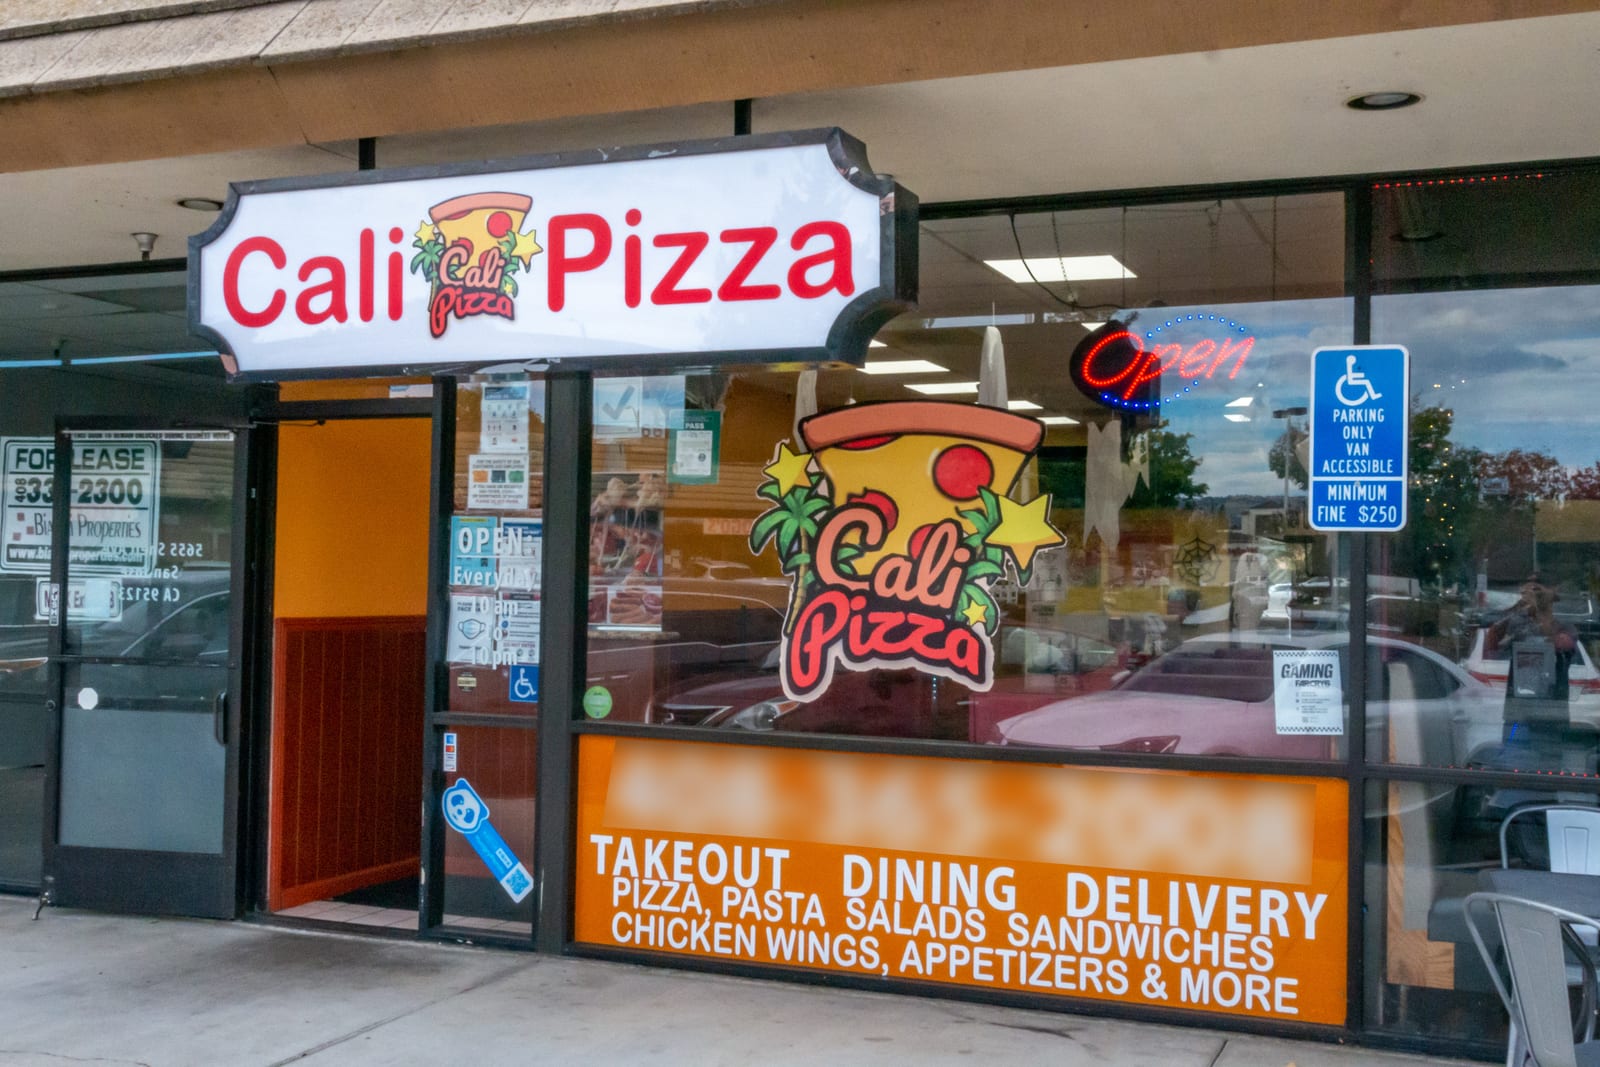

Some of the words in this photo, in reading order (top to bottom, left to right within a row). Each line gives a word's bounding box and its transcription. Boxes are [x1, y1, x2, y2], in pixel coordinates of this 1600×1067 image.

[222, 226, 405, 328] Cali
[547, 208, 856, 313] Pizza
[439, 246, 506, 289] Cali
[431, 287, 514, 337] Pizza
[1082, 331, 1255, 400] Open
[685, 422, 705, 430] PASS
[1333, 408, 1384, 423] PARKING
[1343, 426, 1374, 440] ONLY
[1346, 443, 1369, 456] VAN
[1322, 460, 1393, 473] ACCESSIBLE
[15, 478, 27, 503] 408
[26, 477, 143, 505] 33-2300
[1328, 485, 1387, 501] MINIMUM
[1318, 506, 1346, 522] FINE
[1358, 505, 1397, 523] $250
[815, 506, 971, 609] Cali
[790, 590, 980, 689] Pizza
[1281, 663, 1334, 679] GAMING
[590, 834, 790, 890] TAKEOUT
[843, 854, 1016, 911] DINING
[1066, 872, 1328, 940] DELIVERY
[612, 876, 712, 921] PIZZA,
[722, 886, 826, 927] PASTA
[846, 897, 986, 943] SALADS
[1007, 912, 1274, 972] SANDWICHES
[611, 911, 756, 958] CHICKEN
[766, 925, 889, 977] WINGS,
[899, 939, 1129, 995] APPETIZERS
[1140, 963, 1168, 1000] &
[1180, 967, 1299, 1014] MORE
